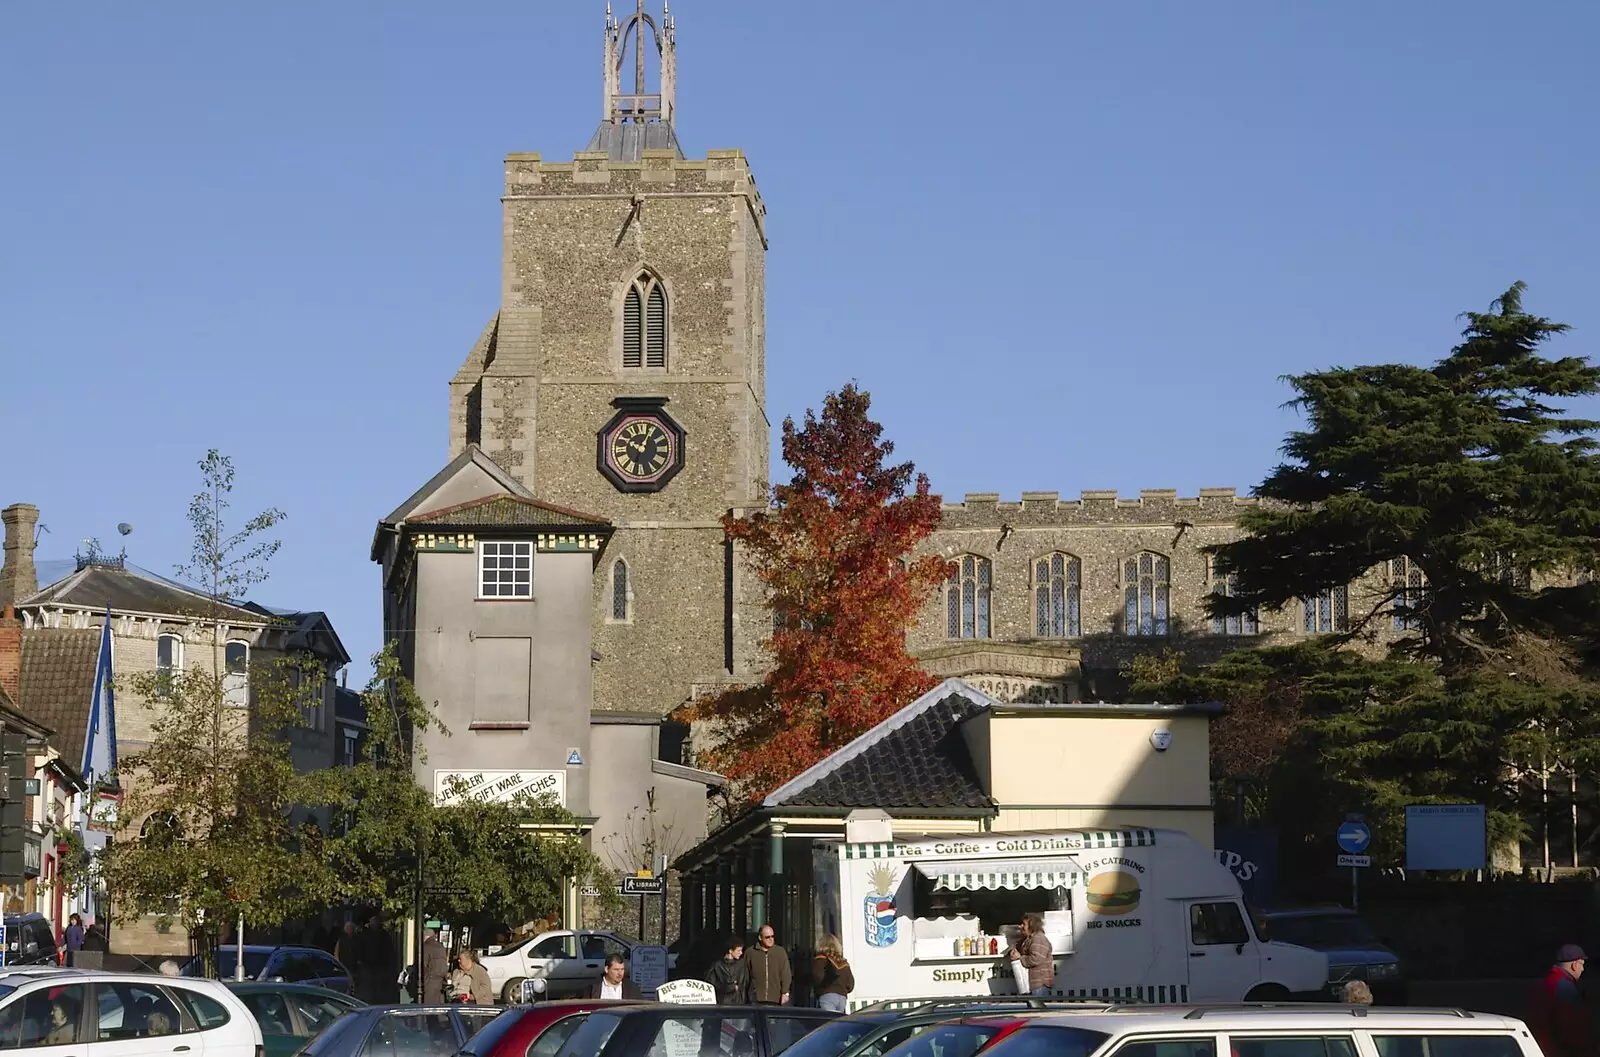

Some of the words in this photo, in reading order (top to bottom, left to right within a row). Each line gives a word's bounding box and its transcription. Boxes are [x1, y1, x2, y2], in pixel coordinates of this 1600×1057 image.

[440, 772, 485, 802] JEWLERY
[474, 786, 495, 802] GIFT
[496, 773, 523, 792] WARE
[512, 774, 556, 800] WATCHES
[896, 845, 922, 856] Tea
[934, 842, 980, 854] Coffee
[996, 840, 1028, 852] Cold
[1032, 838, 1081, 850] Drinks
[1102, 857, 1146, 874] CATERING
[864, 902, 878, 946] PEPSI
[1086, 921, 1102, 929] BIG
[1106, 918, 1142, 928] SNACKS
[932, 968, 984, 982] Simply
[661, 982, 676, 994] BIG
[686, 980, 712, 992] SNAX
